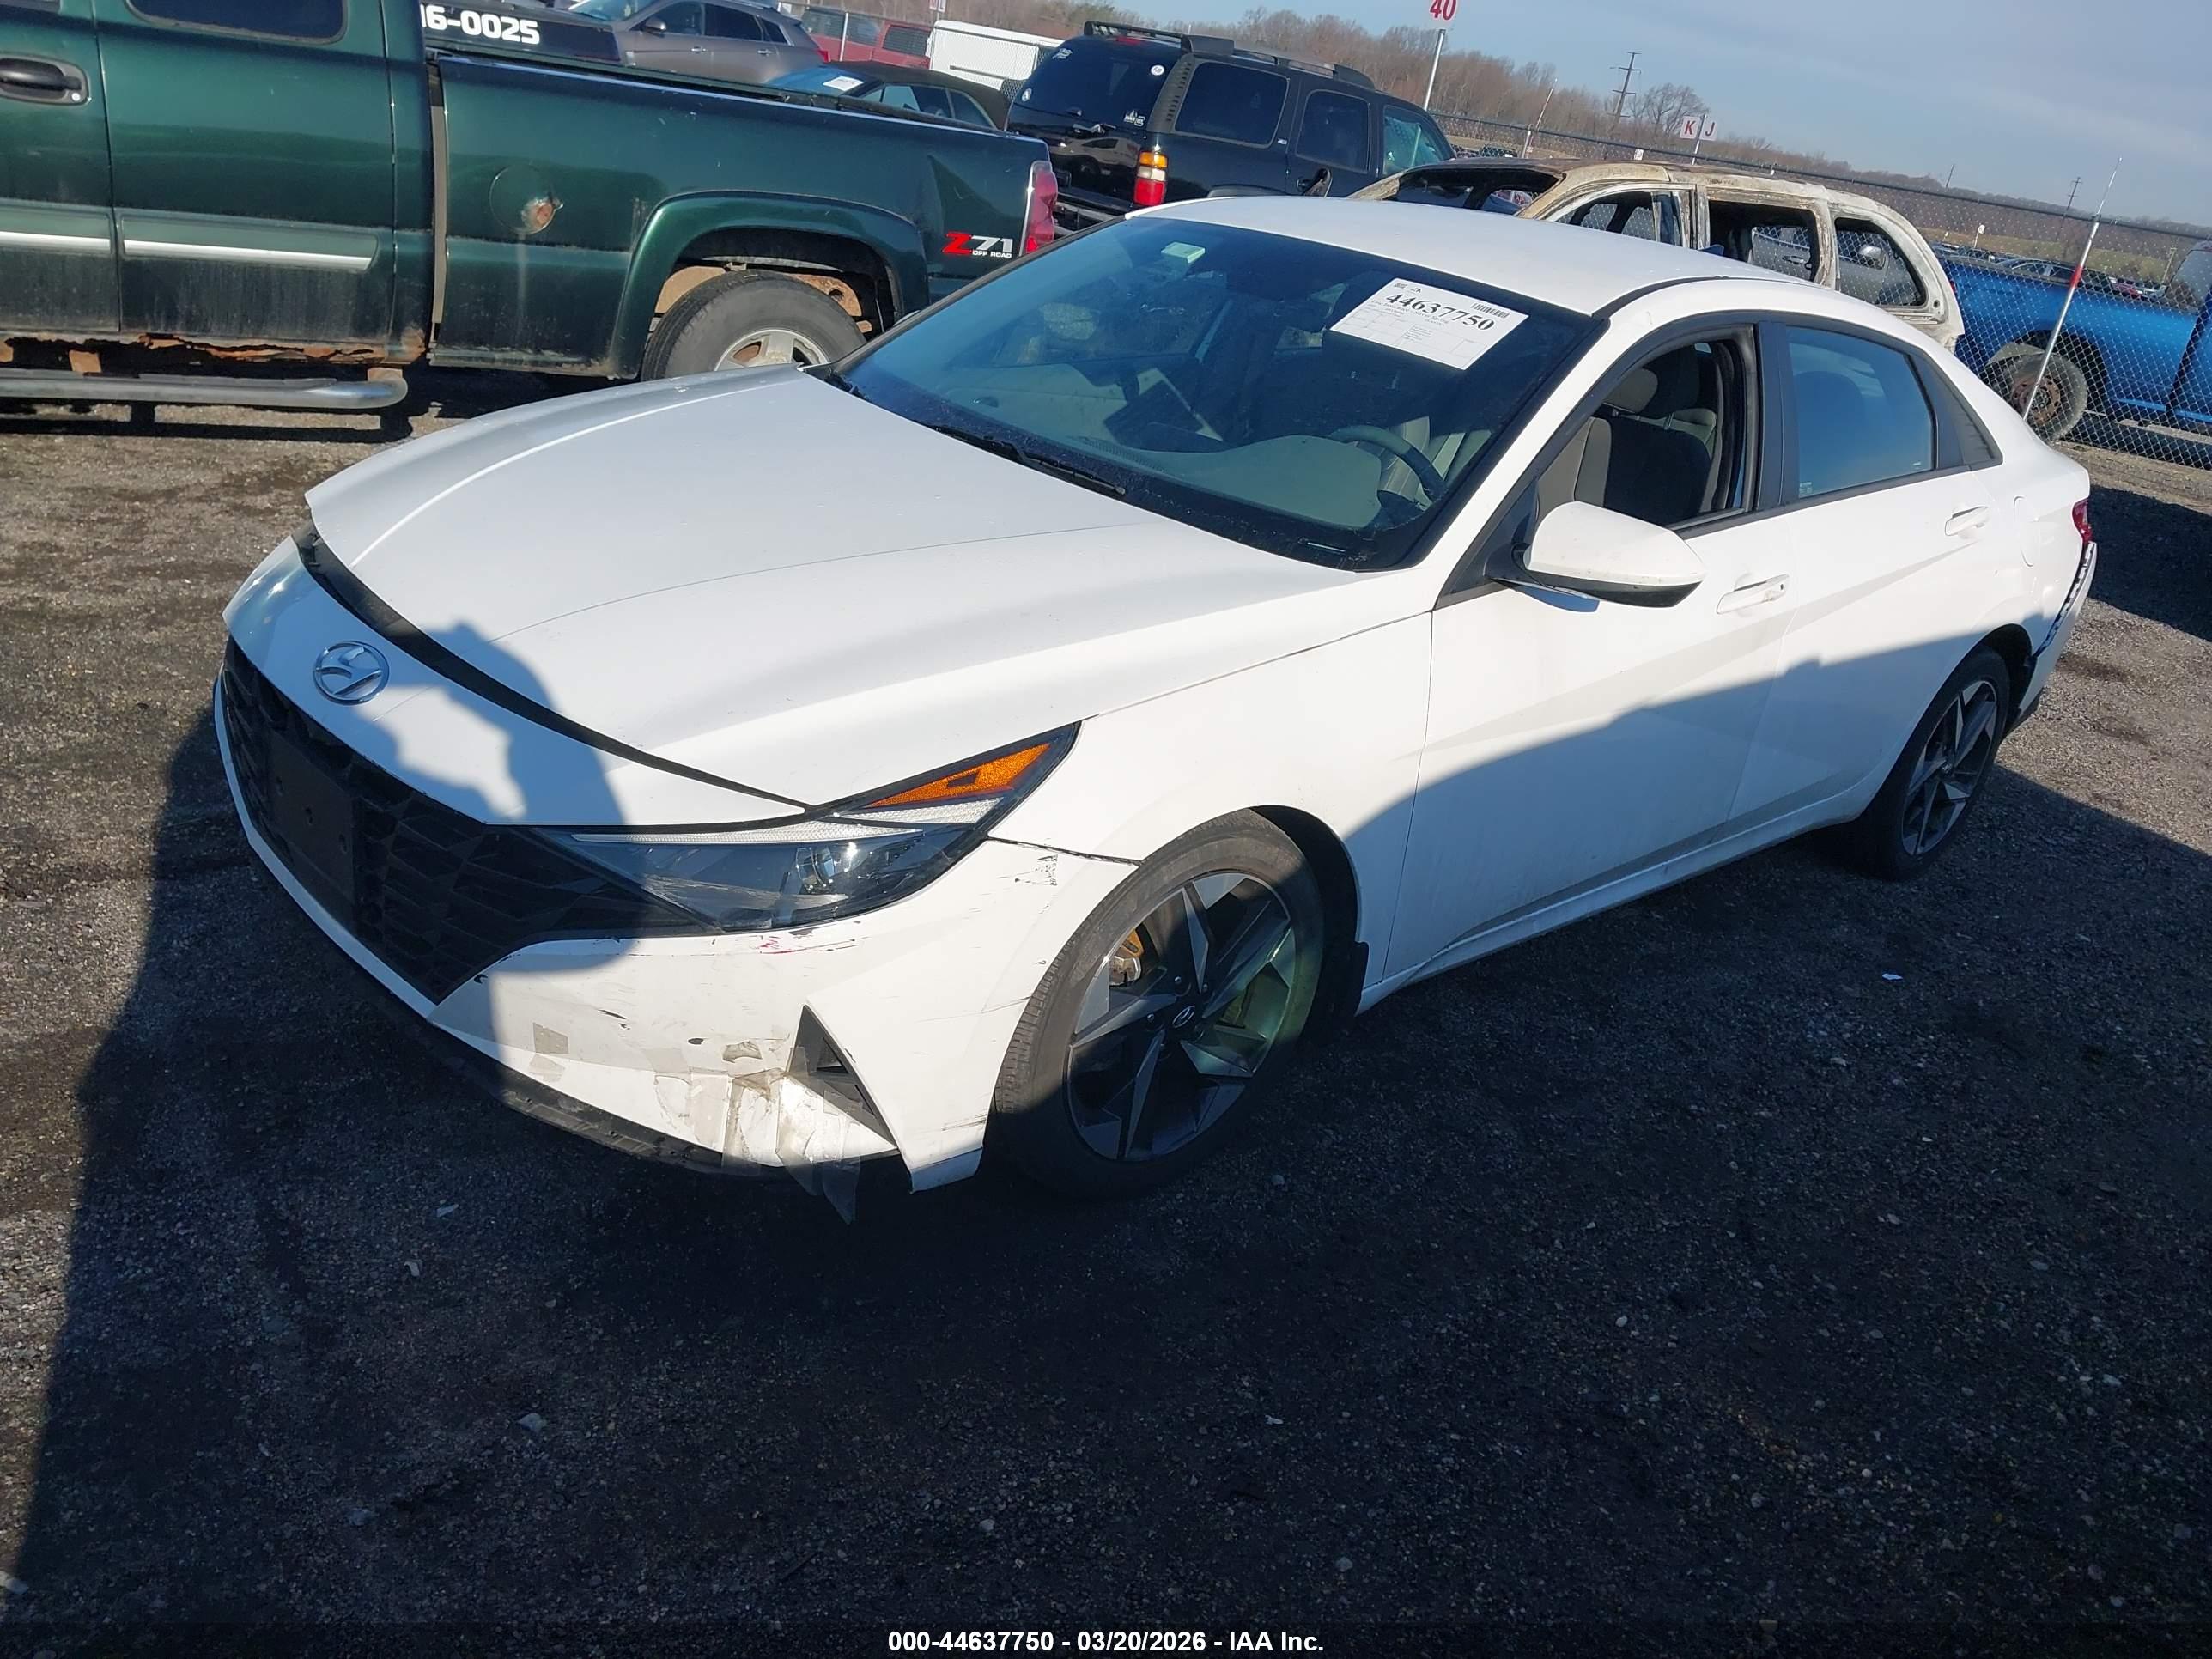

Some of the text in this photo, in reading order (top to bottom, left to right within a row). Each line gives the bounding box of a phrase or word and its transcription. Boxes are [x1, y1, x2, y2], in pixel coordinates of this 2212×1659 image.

[1430, 0, 1457, 20] 40
[1685, 120, 1696, 135] K
[1705, 122, 1715, 136] J
[941, 231, 1013, 256] Z71
[1385, 293, 1495, 331] 44637750
